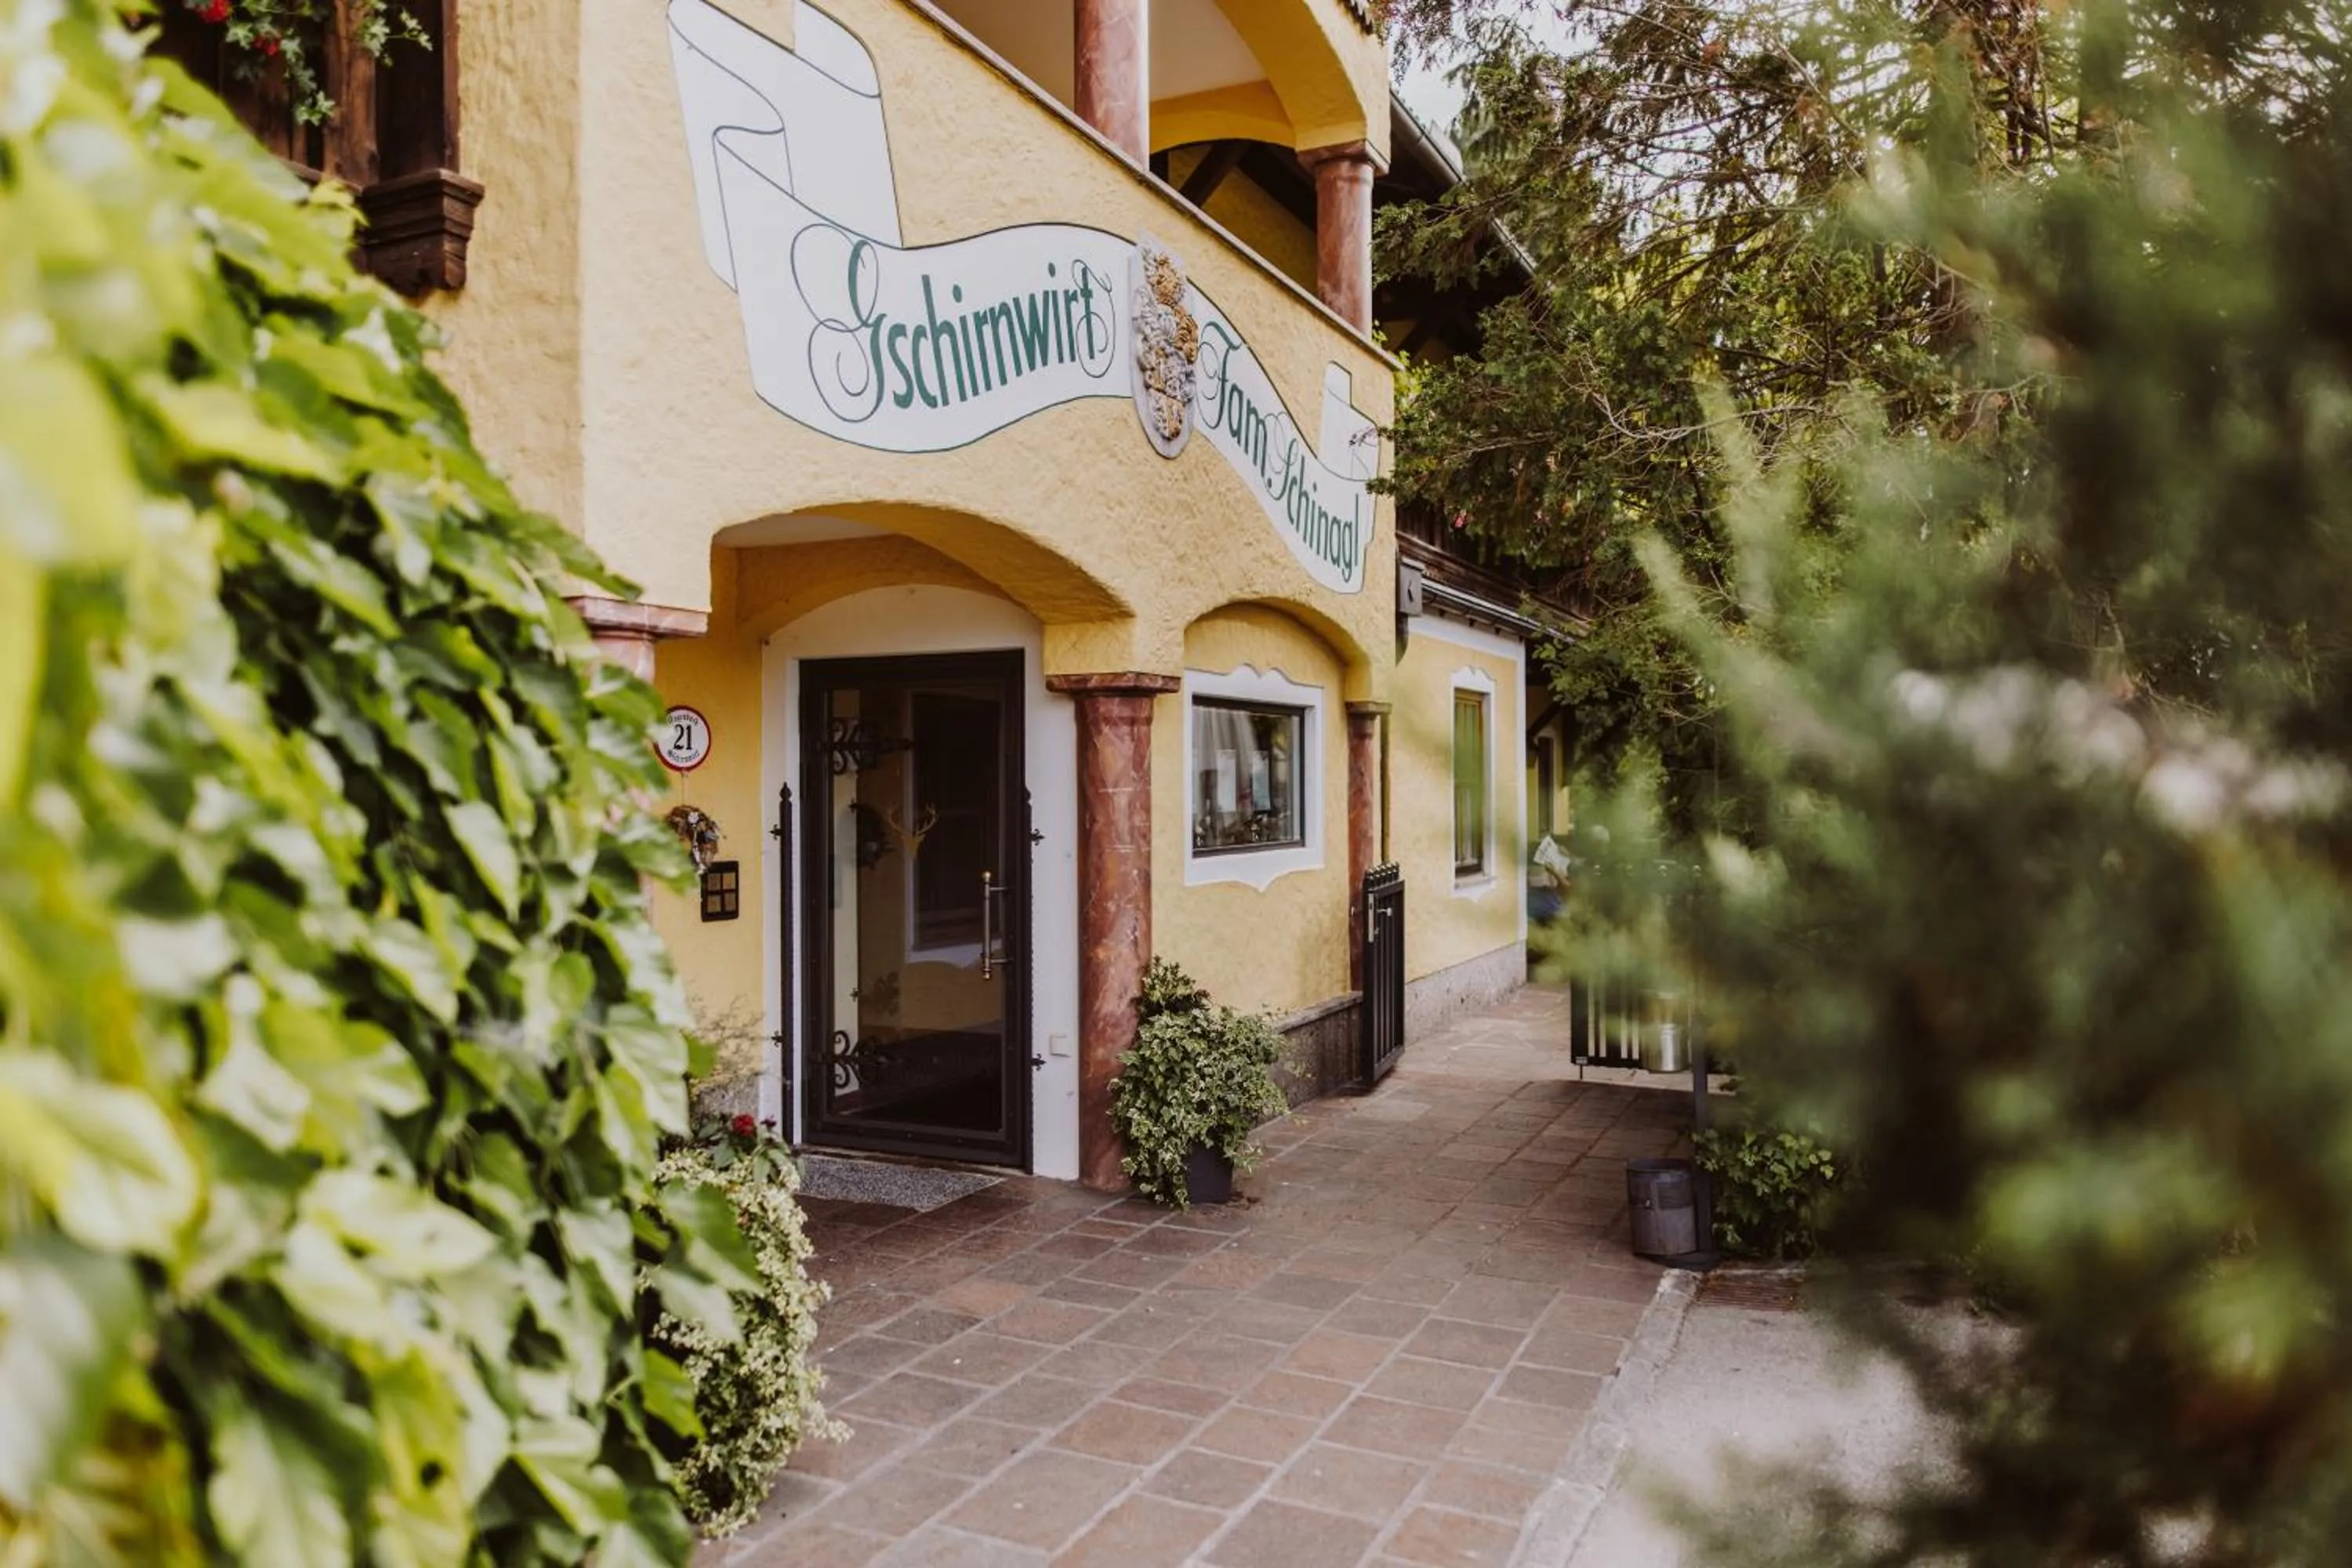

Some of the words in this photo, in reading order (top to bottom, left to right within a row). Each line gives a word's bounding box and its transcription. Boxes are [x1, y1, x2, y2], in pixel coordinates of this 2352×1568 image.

[790, 223, 1116, 423] Gschirnwirt
[1265, 412, 1359, 583] Schinagl
[673, 724, 692, 750] 21
